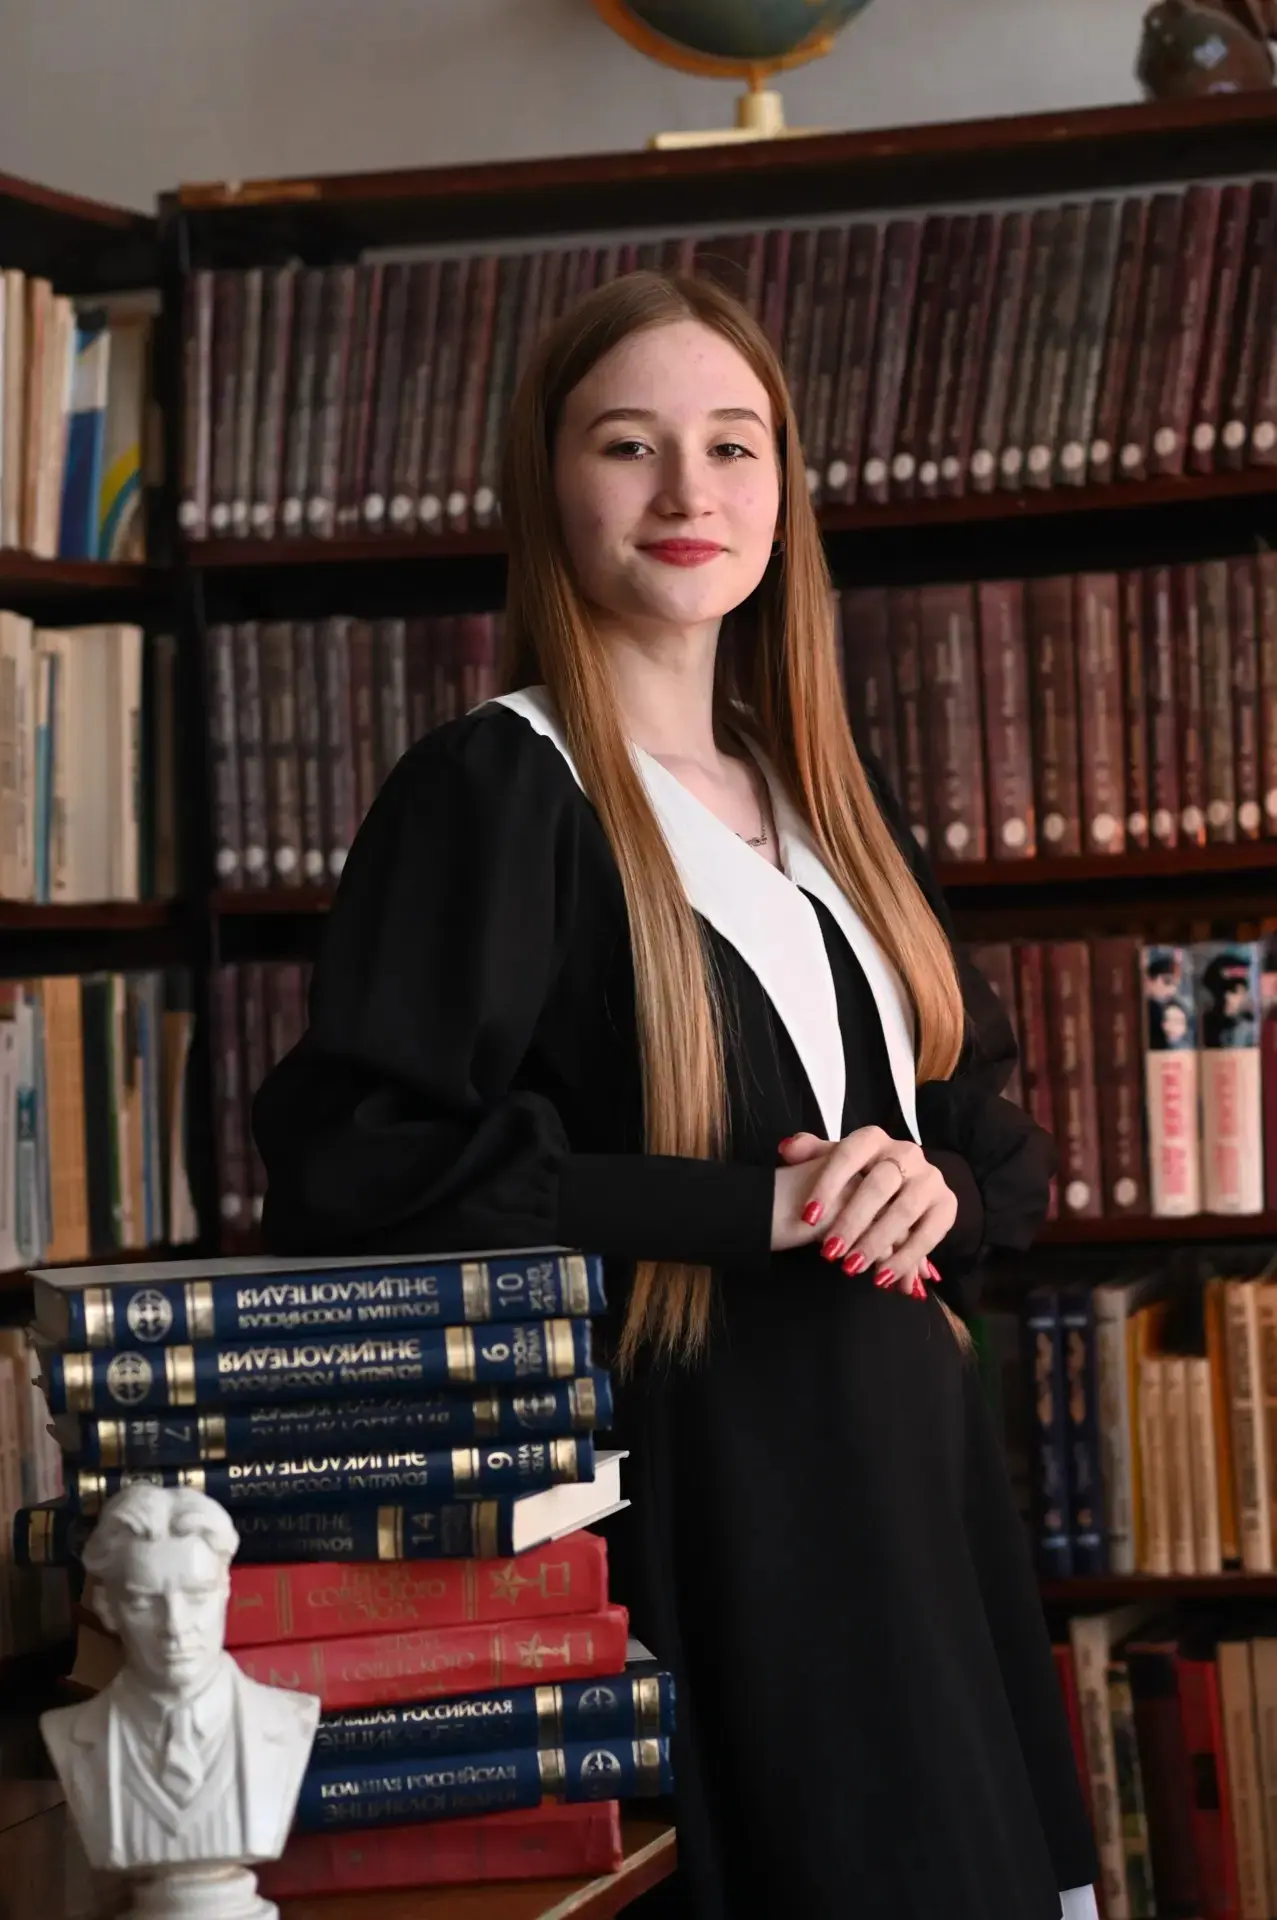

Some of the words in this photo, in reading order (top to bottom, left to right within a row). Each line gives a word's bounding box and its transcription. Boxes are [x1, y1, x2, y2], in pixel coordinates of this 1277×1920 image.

[237, 1276, 438, 1309] ЭНЦИКЛОПЕДИЯ
[497, 1273, 523, 1305] 10
[238, 1306, 353, 1329] РОССИЙСКАЯ
[358, 1301, 440, 1321] БОЛЬШАЯ
[218, 1338, 422, 1373] ЭНЦИКЛОПЕДИЯ
[164, 1426, 191, 1442] 7
[411, 1511, 436, 1546] 14
[402, 1699, 513, 1722] РОССИЙСКАЯ
